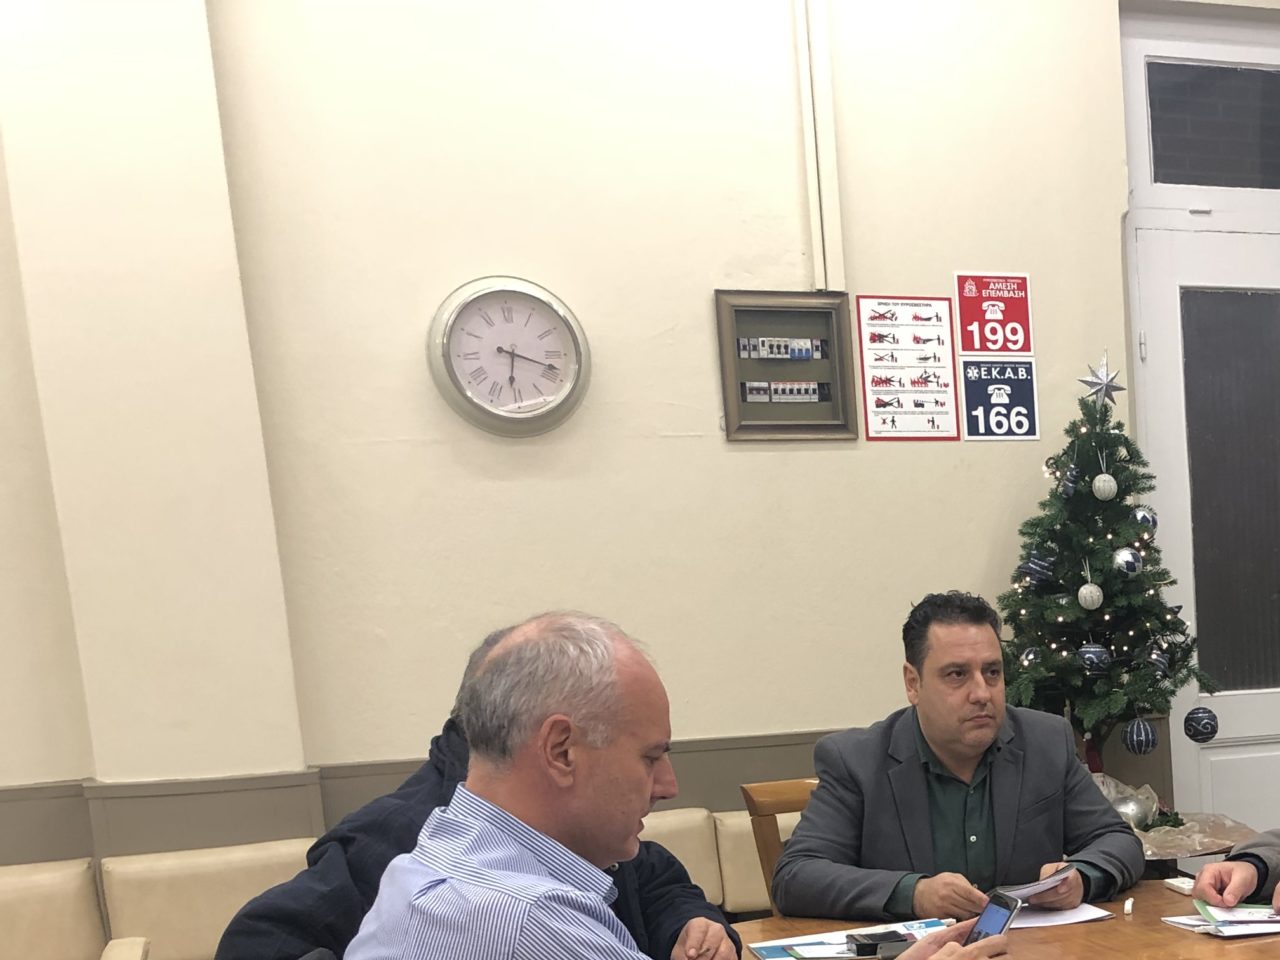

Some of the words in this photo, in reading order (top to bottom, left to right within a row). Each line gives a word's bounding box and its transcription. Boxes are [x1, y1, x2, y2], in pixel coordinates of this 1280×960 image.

[989, 282, 1017, 290] ΑΜΕΣΗ
[982, 289, 1025, 298] ΕΠΕΜΒΑΣΗ
[966, 321, 1025, 350] 199
[981, 367, 1031, 379] Ε.Κ.Α.Β.
[971, 406, 1030, 435] 166
